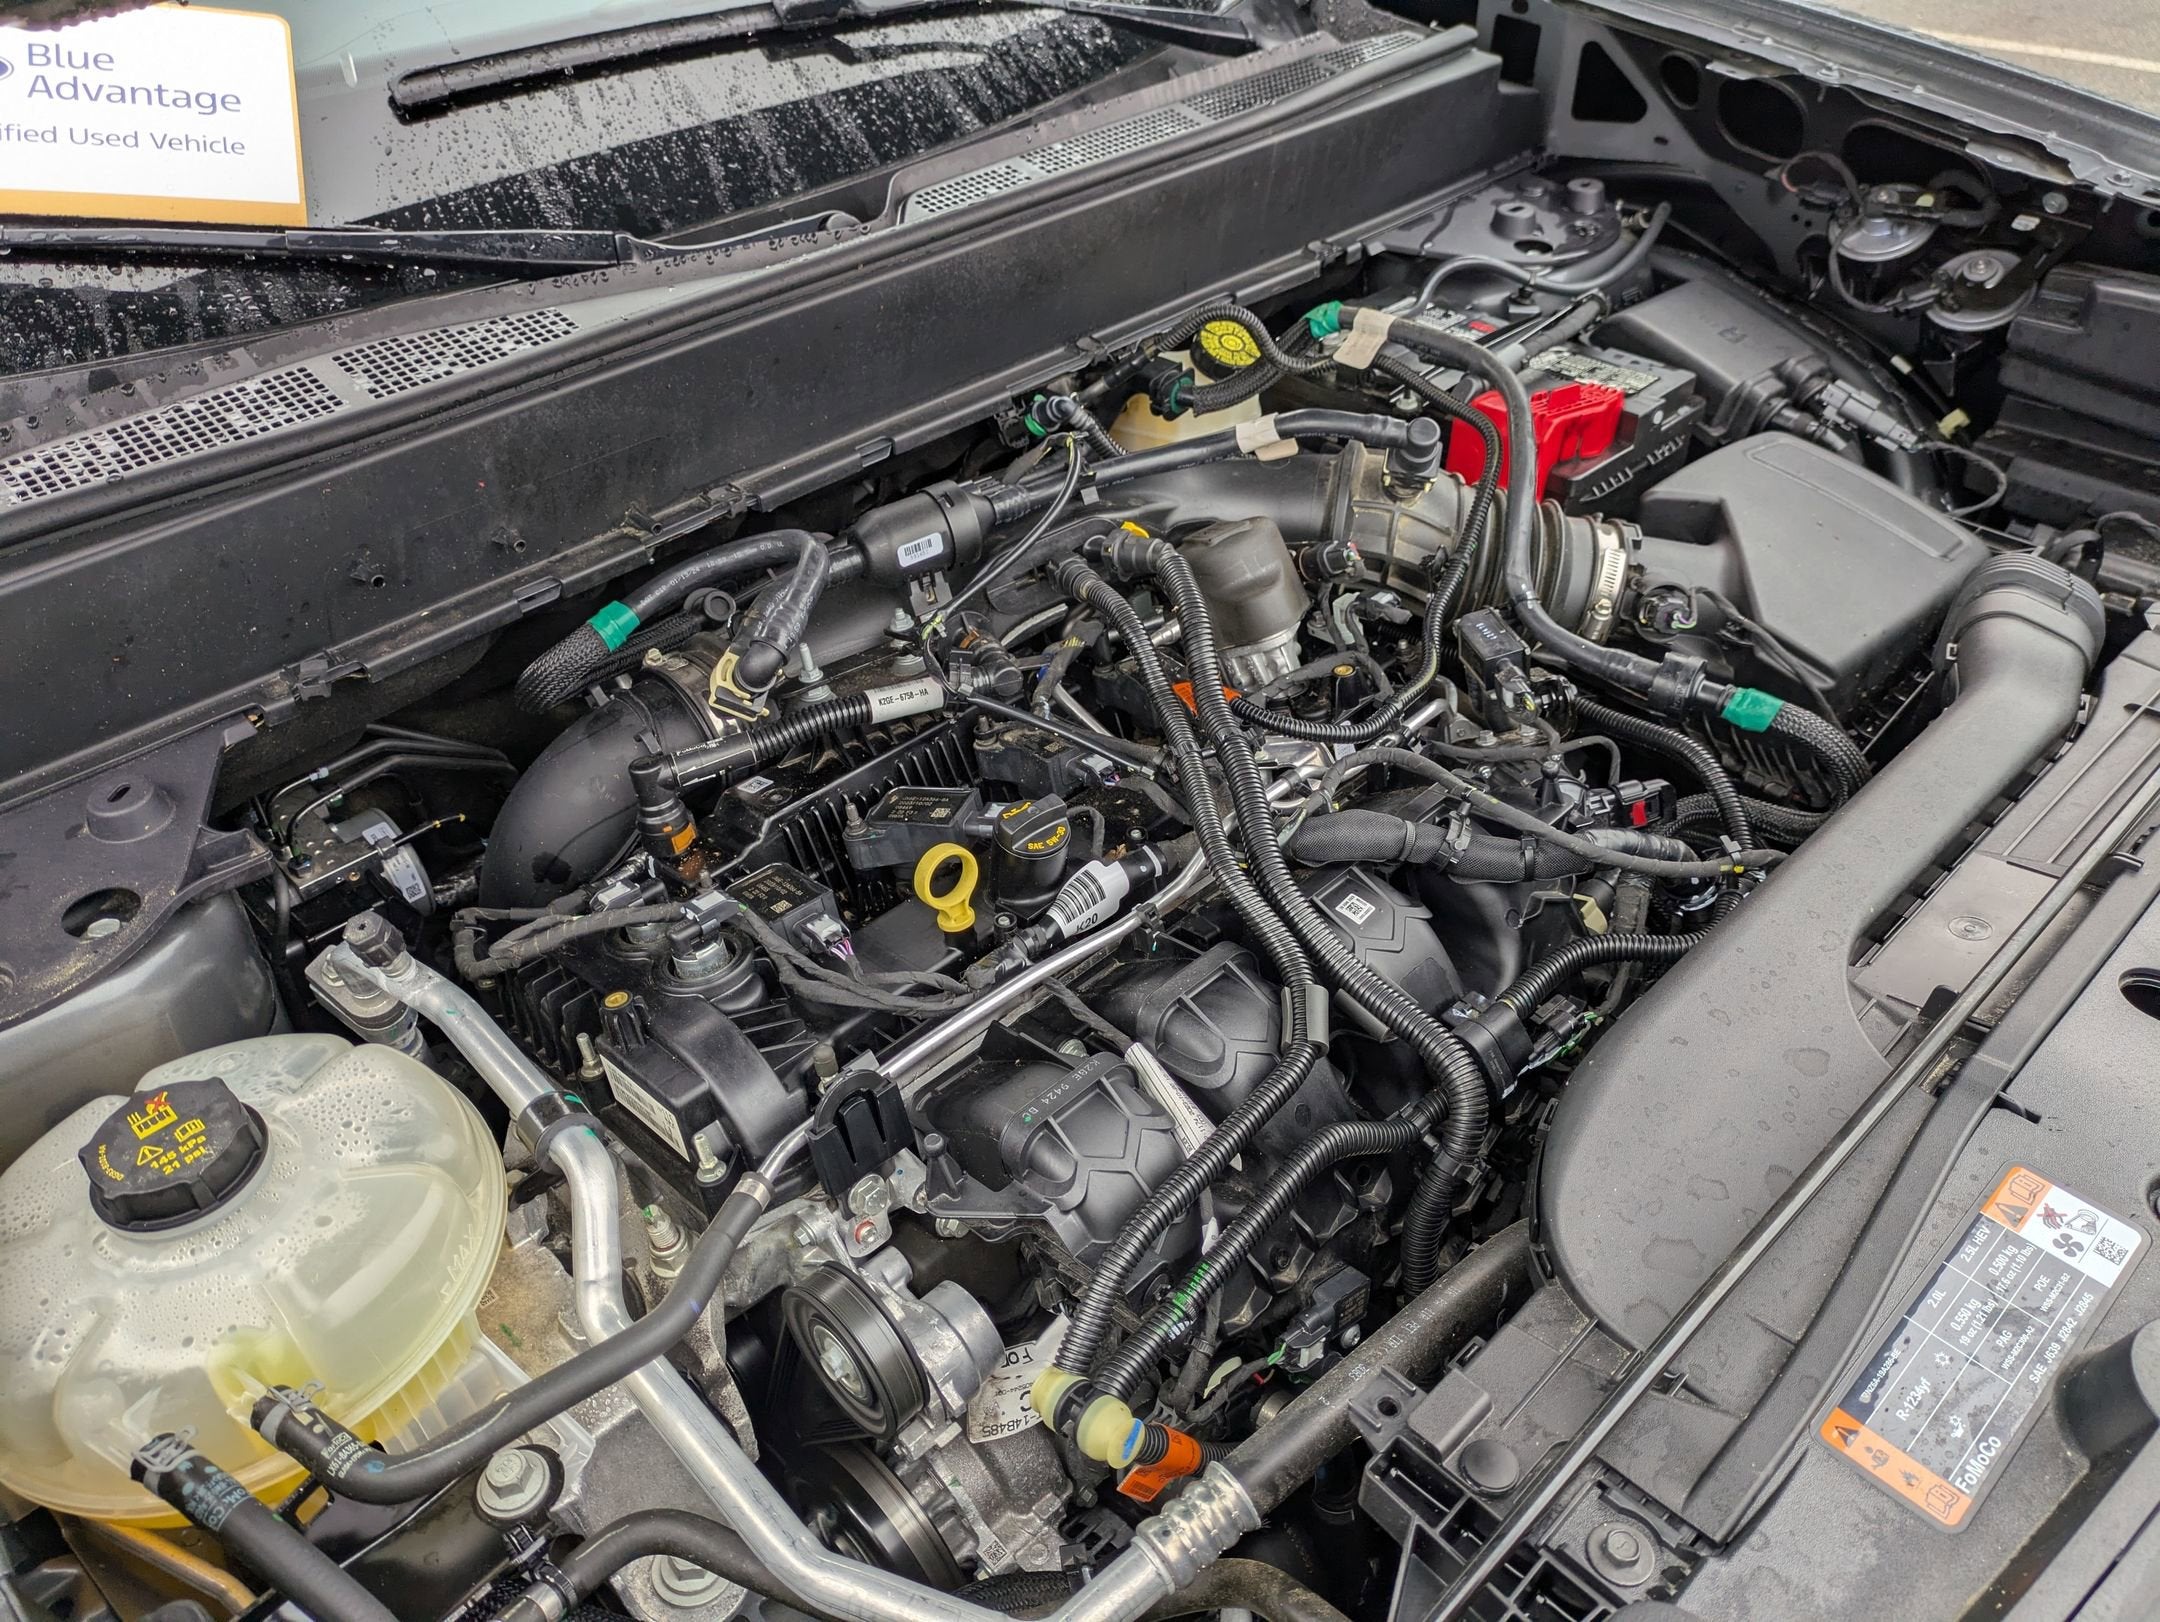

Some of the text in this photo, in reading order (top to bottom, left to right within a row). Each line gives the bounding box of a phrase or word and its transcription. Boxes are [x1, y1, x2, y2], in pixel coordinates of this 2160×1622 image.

[27, 43, 115, 71] Blue
[27, 74, 242, 116] Advantage
[69, 127, 139, 149] Used
[150, 132, 246, 155] Vehicle
[1045, 826, 1065, 846] 5W-30
[1040, 1079, 1069, 1107] 9424
[148, 1149, 177, 1170] 145
[177, 1133, 207, 1154] kPa
[161, 1144, 207, 1175] 21 psi
[447, 1223, 481, 1281] MAX
[1960, 1224, 1992, 1263] 2.5L HEV
[1987, 1242, 2019, 1277] 0.500 kg
[2006, 1269, 2016, 1280] oz
[2019, 1241, 2036, 1258] lbs)
[1928, 1287, 1947, 1309] 2.0L
[2033, 1274, 2050, 1292] POE
[1951, 1296, 1980, 1332] 0.550 kg
[1959, 1335, 1971, 1347] 19
[1966, 1327, 1977, 1339] oz
[1981, 1297, 1998, 1315] lbs)
[1995, 1329, 2013, 1348] PAG
[2028, 1291, 2094, 1384] SAE J639 J2842 J2845
[1895, 1375, 1932, 1422] R-1234yf
[1954, 1432, 2003, 1494] FoMoCo
